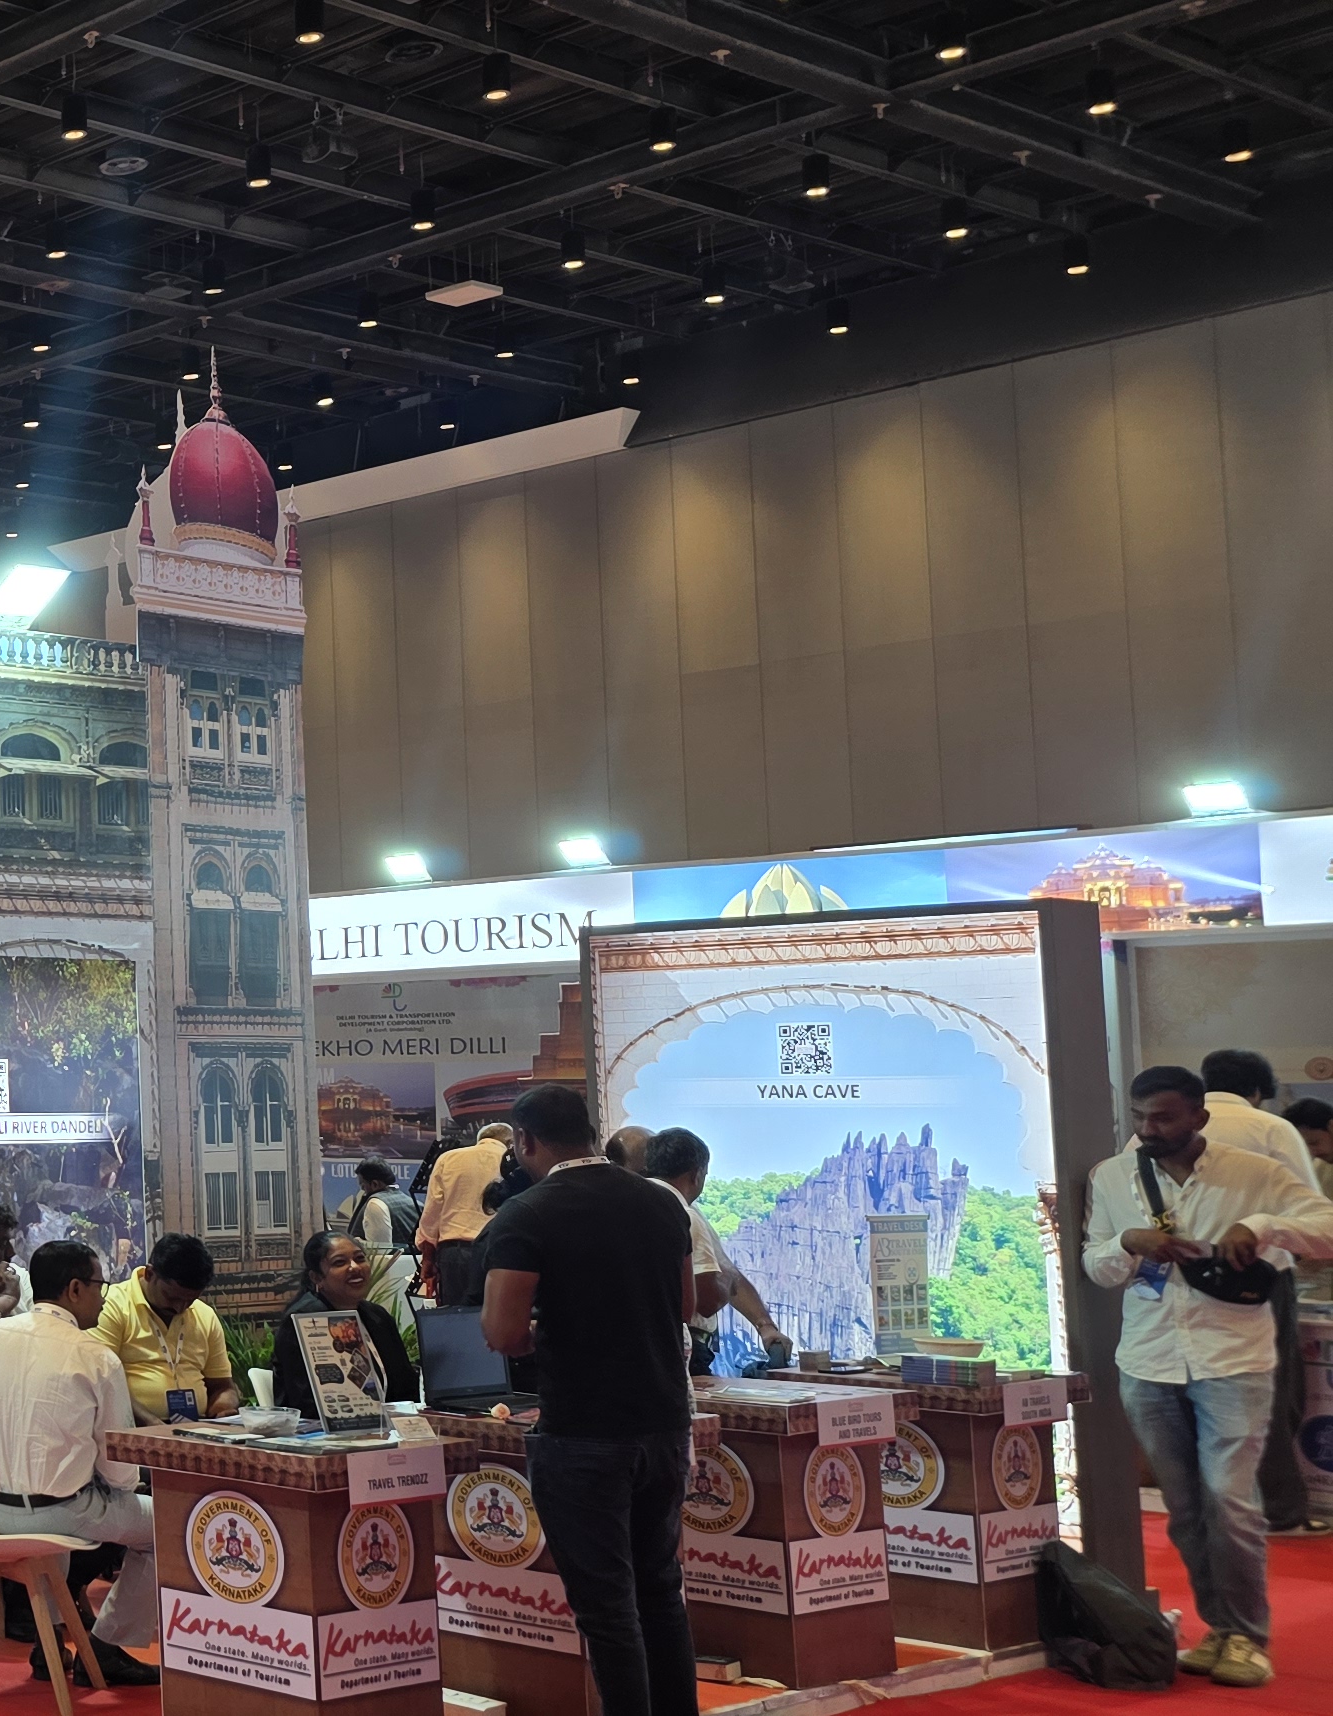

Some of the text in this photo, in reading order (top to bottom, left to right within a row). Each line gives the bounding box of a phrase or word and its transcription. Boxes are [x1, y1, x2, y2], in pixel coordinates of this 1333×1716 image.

[310, 909, 598, 961] LHI TOURISM
[338, 1020, 384, 1028] DEVELOPMENT
[386, 1019, 437, 1027] CORPORATION
[395, 1011, 456, 1019] TRANSPORTATION
[382, 1037, 440, 1056] MERI
[450, 1036, 507, 1055] DILLI
[756, 1084, 861, 1099] YANA CAVE
[12, 1119, 47, 1135] RIVER
[51, 1118, 103, 1135] DANDELI
[874, 1221, 924, 1232] TRAVEL DESK
[1030, 1395, 1051, 1406] TRAVELS
[831, 1411, 882, 1427] BLUE BIRD TOURS
[1021, 1408, 1052, 1421] SOUTH INDIA
[838, 1426, 877, 1439] AND TRAVELS
[920, 1446, 933, 1460] OF
[367, 1472, 429, 1491] TRAVEL TRENDZZ
[729, 1467, 743, 1487] OF
[457, 1470, 534, 1513] GOVERNMENT OF
[883, 1489, 927, 1506] RNATAKA
[196, 1501, 272, 1546] GOVERNMENT OF
[346, 1505, 405, 1548] GOVERNMENT OF
[818, 1511, 856, 1533] KARNATAKA
[984, 1519, 1057, 1559] Karnataka
[469, 1539, 530, 1564] KARNATAKA
[911, 1545, 971, 1561] Many worlds.
[795, 1546, 884, 1591] Karnataka
[902, 1560, 912, 1568] of
[914, 1561, 953, 1574] Tourism
[208, 1573, 267, 1600] KARNATAKA
[435, 1562, 573, 1617] Karnataka
[694, 1571, 719, 1582] state.
[722, 1574, 746, 1587] Many
[748, 1580, 782, 1590] worlds.
[355, 1579, 402, 1606] KARNATAKA
[713, 1588, 723, 1599] of
[725, 1590, 763, 1604] Tourism
[465, 1602, 483, 1613] One
[485, 1606, 510, 1617] state.
[513, 1611, 538, 1624] Many
[166, 1598, 310, 1660] Karnataka
[448, 1615, 555, 1643] Department of Tourism
[323, 1619, 435, 1672] Karnataka
[204, 1641, 310, 1672] One state. Many worlds.
[353, 1657, 368, 1668] One
[369, 1654, 389, 1665] state.
[391, 1650, 409, 1662] Many
[187, 1655, 291, 1687] Department of Tourism
[340, 1667, 422, 1690] Department of Tourism
